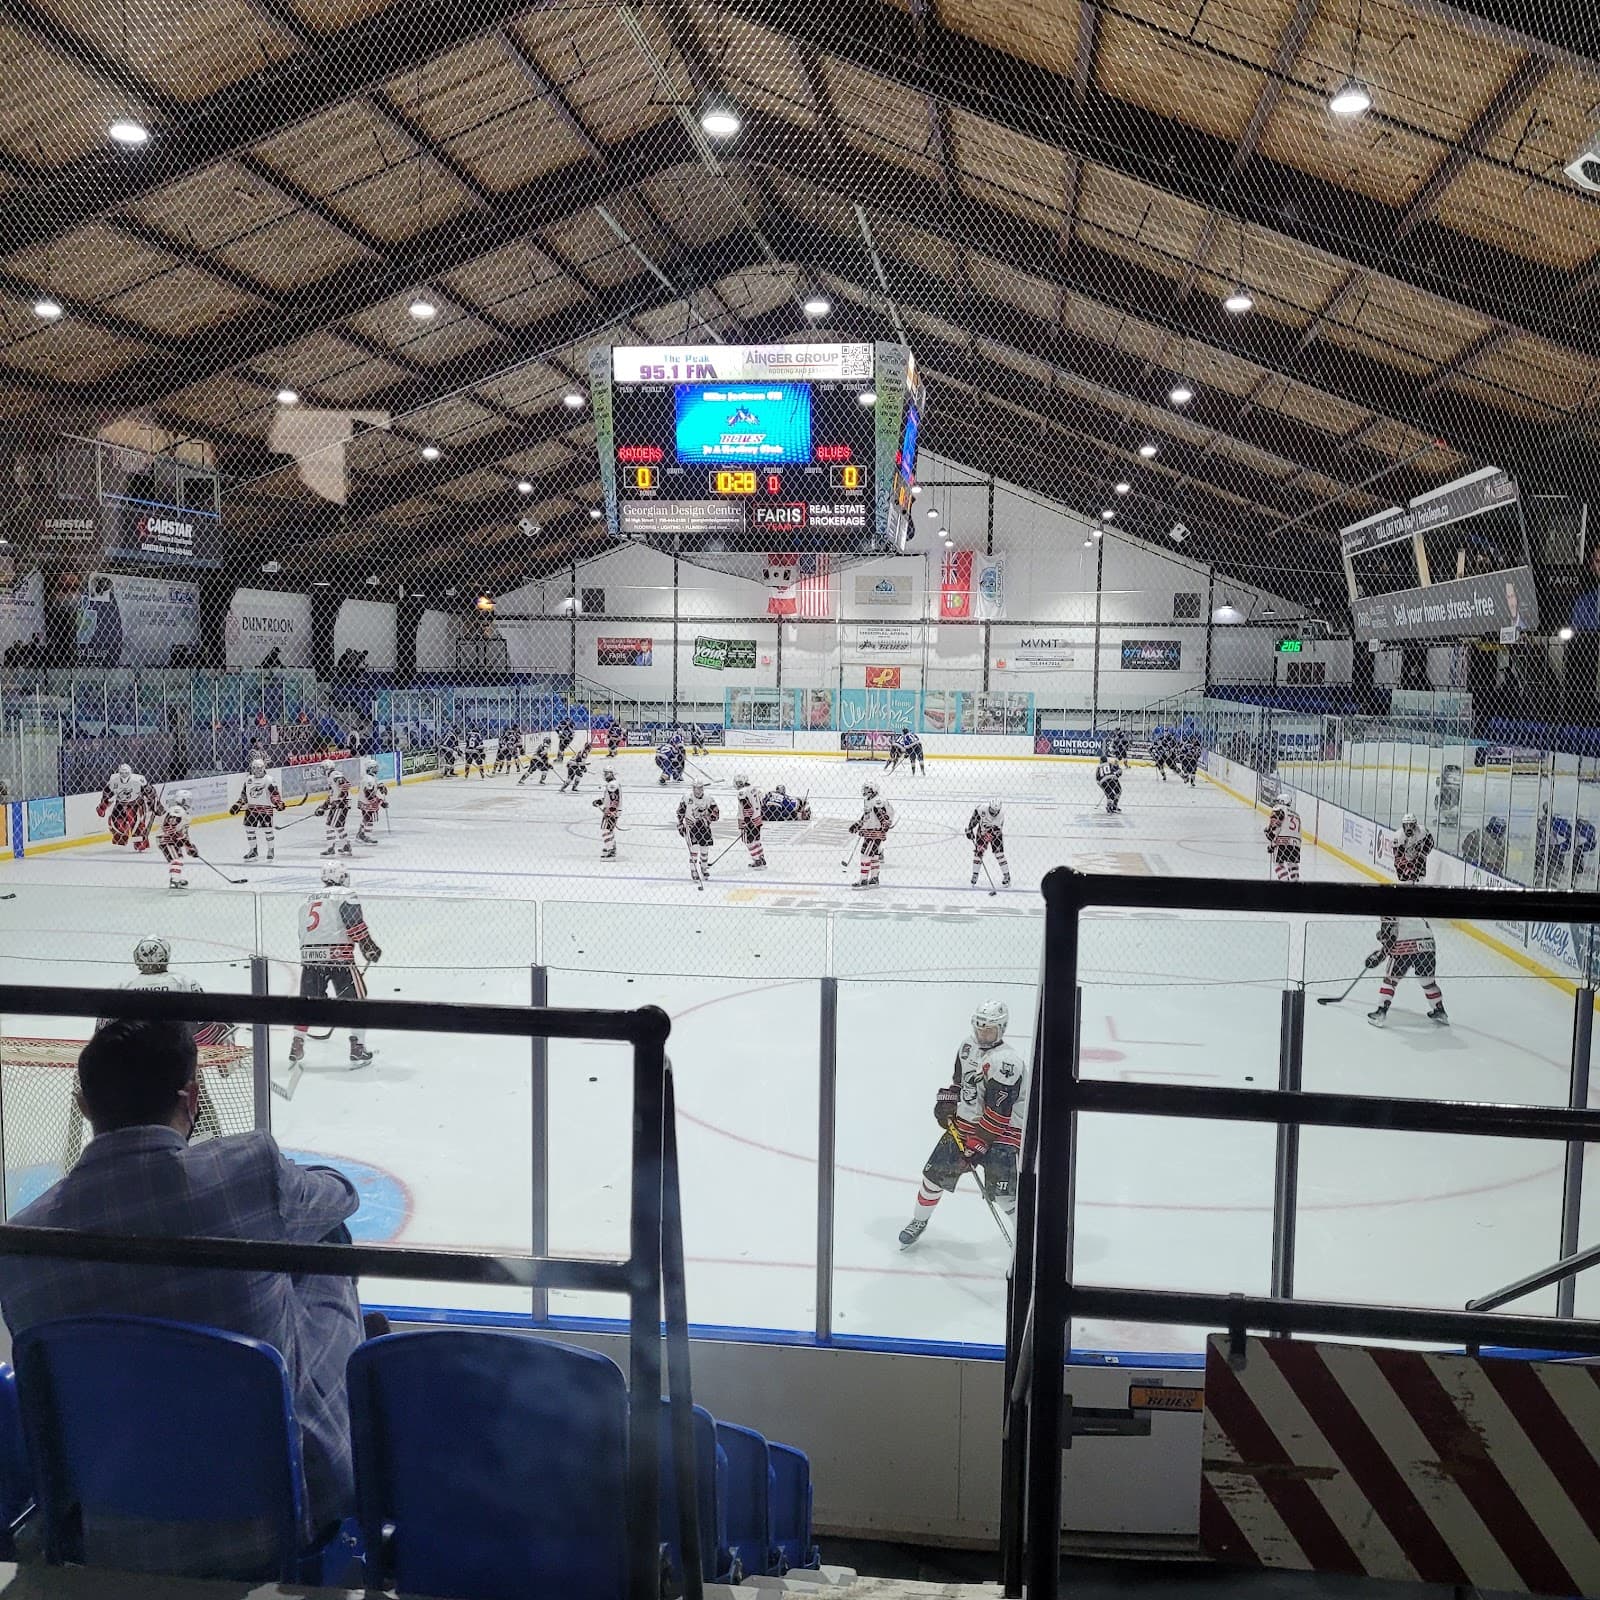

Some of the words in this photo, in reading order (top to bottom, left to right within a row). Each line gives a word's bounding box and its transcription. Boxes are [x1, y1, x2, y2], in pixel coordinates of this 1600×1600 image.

[664, 353, 680, 362] The
[685, 353, 709, 362] Peak
[796, 353, 839, 363] GROUP
[640, 364, 679, 379] 95.1
[686, 363, 718, 379] FM
[620, 448, 662, 460] RAIDERS
[818, 447, 851, 458] BLUES
[637, 468, 650, 488] 0
[768, 476, 779, 491] 0
[845, 467, 857, 488] 0
[623, 505, 668, 516] Georgian
[671, 505, 704, 516] Design
[707, 505, 741, 515] Centre
[757, 508, 801, 522] FARIS
[809, 505, 832, 513] REAL
[834, 505, 866, 513] ESTATE
[147, 517, 193, 537] CARSTAR
[809, 517, 866, 526] BROKERAGE
[1393, 602, 1407, 626] Sell
[1406, 606, 1422, 631] your
[1423, 600, 1446, 623] home
[1447, 588, 1494, 621] stress-free
[242, 616, 293, 632] DUNTROON
[1021, 639, 1059, 648] MVMT
[609, 652, 627, 660] FARIS
[697, 646, 727, 661] YOUR
[1053, 740, 1101, 749] DUNTROON
[307, 902, 323, 932] 5
[1531, 921, 1569, 955] Wiley
[309, 951, 327, 959] WINGS
[996, 1090, 1009, 1107] 7
[1147, 1397, 1194, 1408] BLUES
